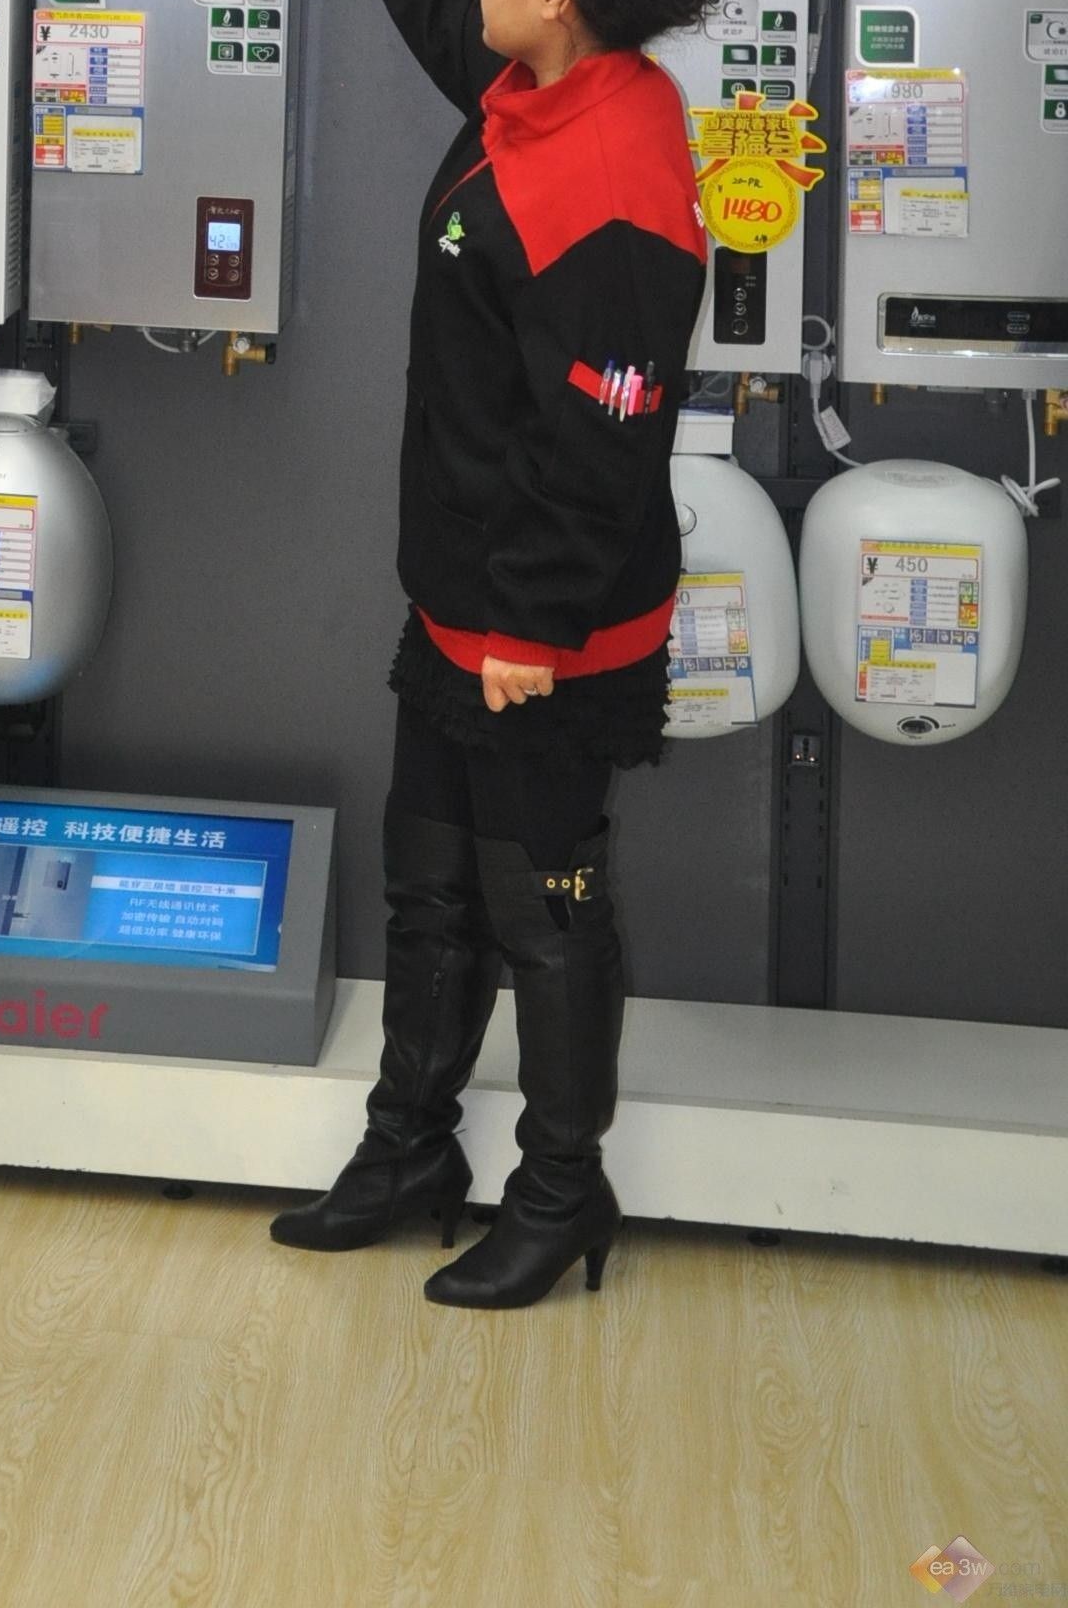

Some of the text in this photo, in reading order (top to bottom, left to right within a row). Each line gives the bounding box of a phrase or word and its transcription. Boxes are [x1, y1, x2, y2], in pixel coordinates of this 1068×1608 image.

[69, 24, 110, 39] 2430
[722, 197, 783, 223] 1480
[895, 557, 929, 574] 450
[64, 820, 226, 850] 科技便捷生活
